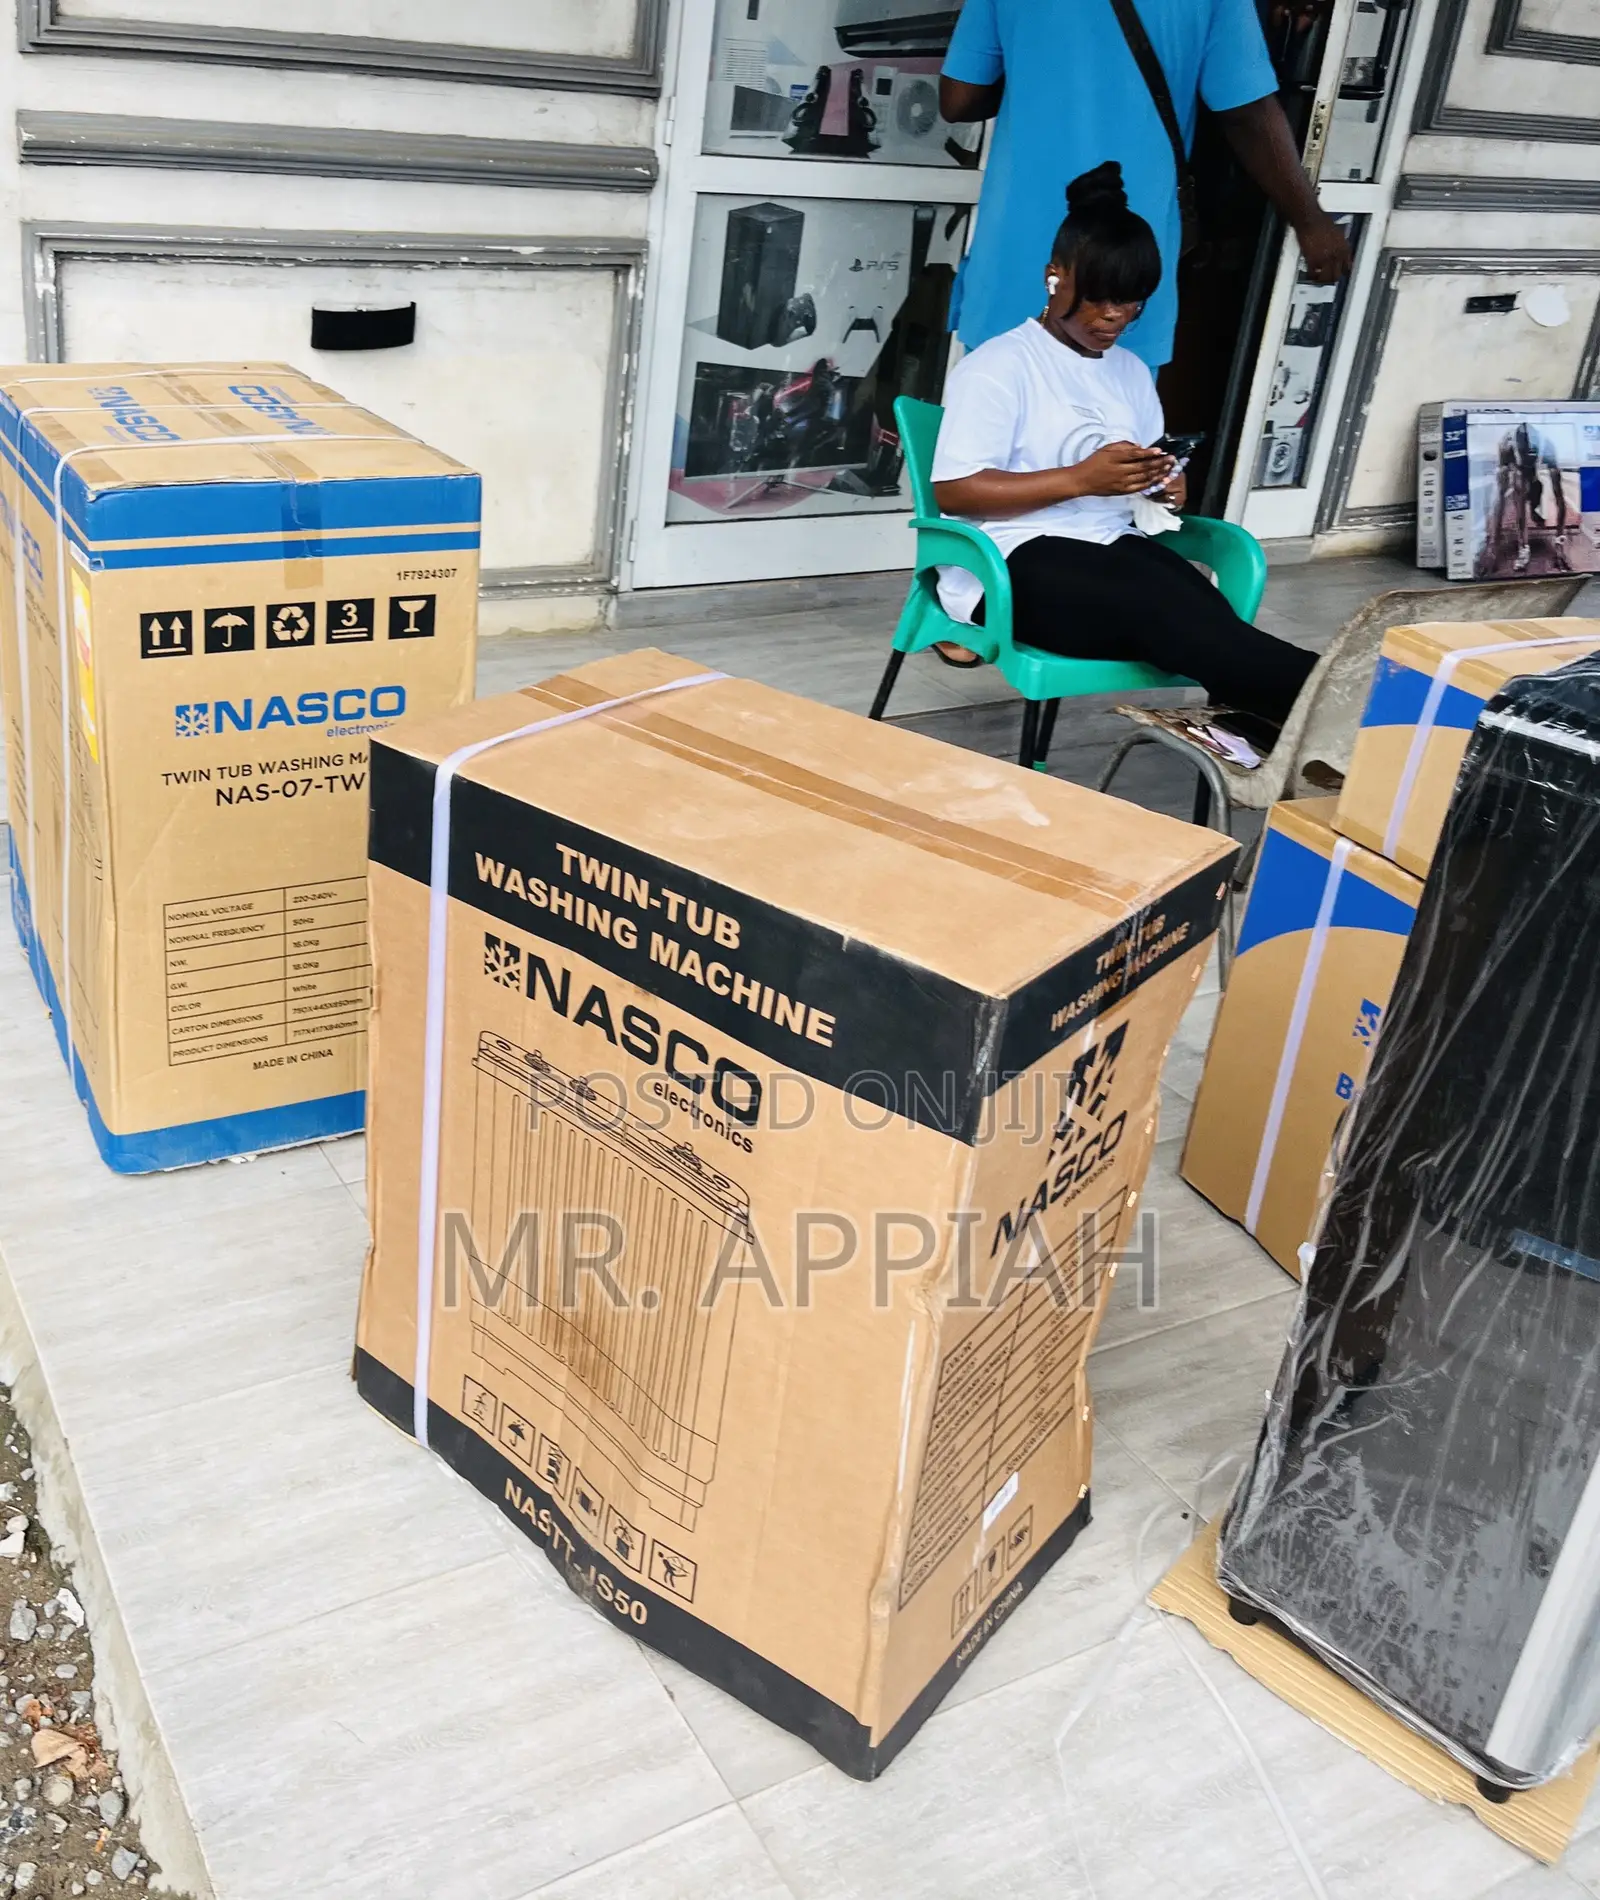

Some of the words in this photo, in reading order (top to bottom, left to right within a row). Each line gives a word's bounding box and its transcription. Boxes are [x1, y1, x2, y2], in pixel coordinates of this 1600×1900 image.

[866, 260, 899, 271] PS5
[396, 567, 458, 581] 1F7924307
[214, 685, 406, 734] NASCO
[161, 769, 211, 786] TWIN
[217, 764, 253, 780] TUB
[259, 753, 344, 775] WASHING
[556, 842, 741, 950] TWIN-TUB
[168, 910, 209, 921] NOMINAL
[212, 903, 254, 915] VOLTAGE
[169, 932, 210, 944] NOMINAL
[212, 924, 265, 938] FREQUENCY
[475, 852, 638, 951] WASHING
[650, 931, 837, 1048] MACHINE
[171, 1002, 201, 1013] COLOR
[171, 1024, 209, 1035] CARTON
[210, 1014, 263, 1029] DIMENSIONS
[173, 1045, 214, 1057] PRODUCT
[216, 1035, 269, 1050] DIMENSIONS
[527, 954, 762, 1127] NASCO
[252, 1055, 284, 1070] MADE
[287, 1053, 298, 1064] IN
[300, 1048, 333, 1061] CHINA
[653, 1079, 754, 1154] electronics
[990, 1110, 1128, 1260] NASCO
